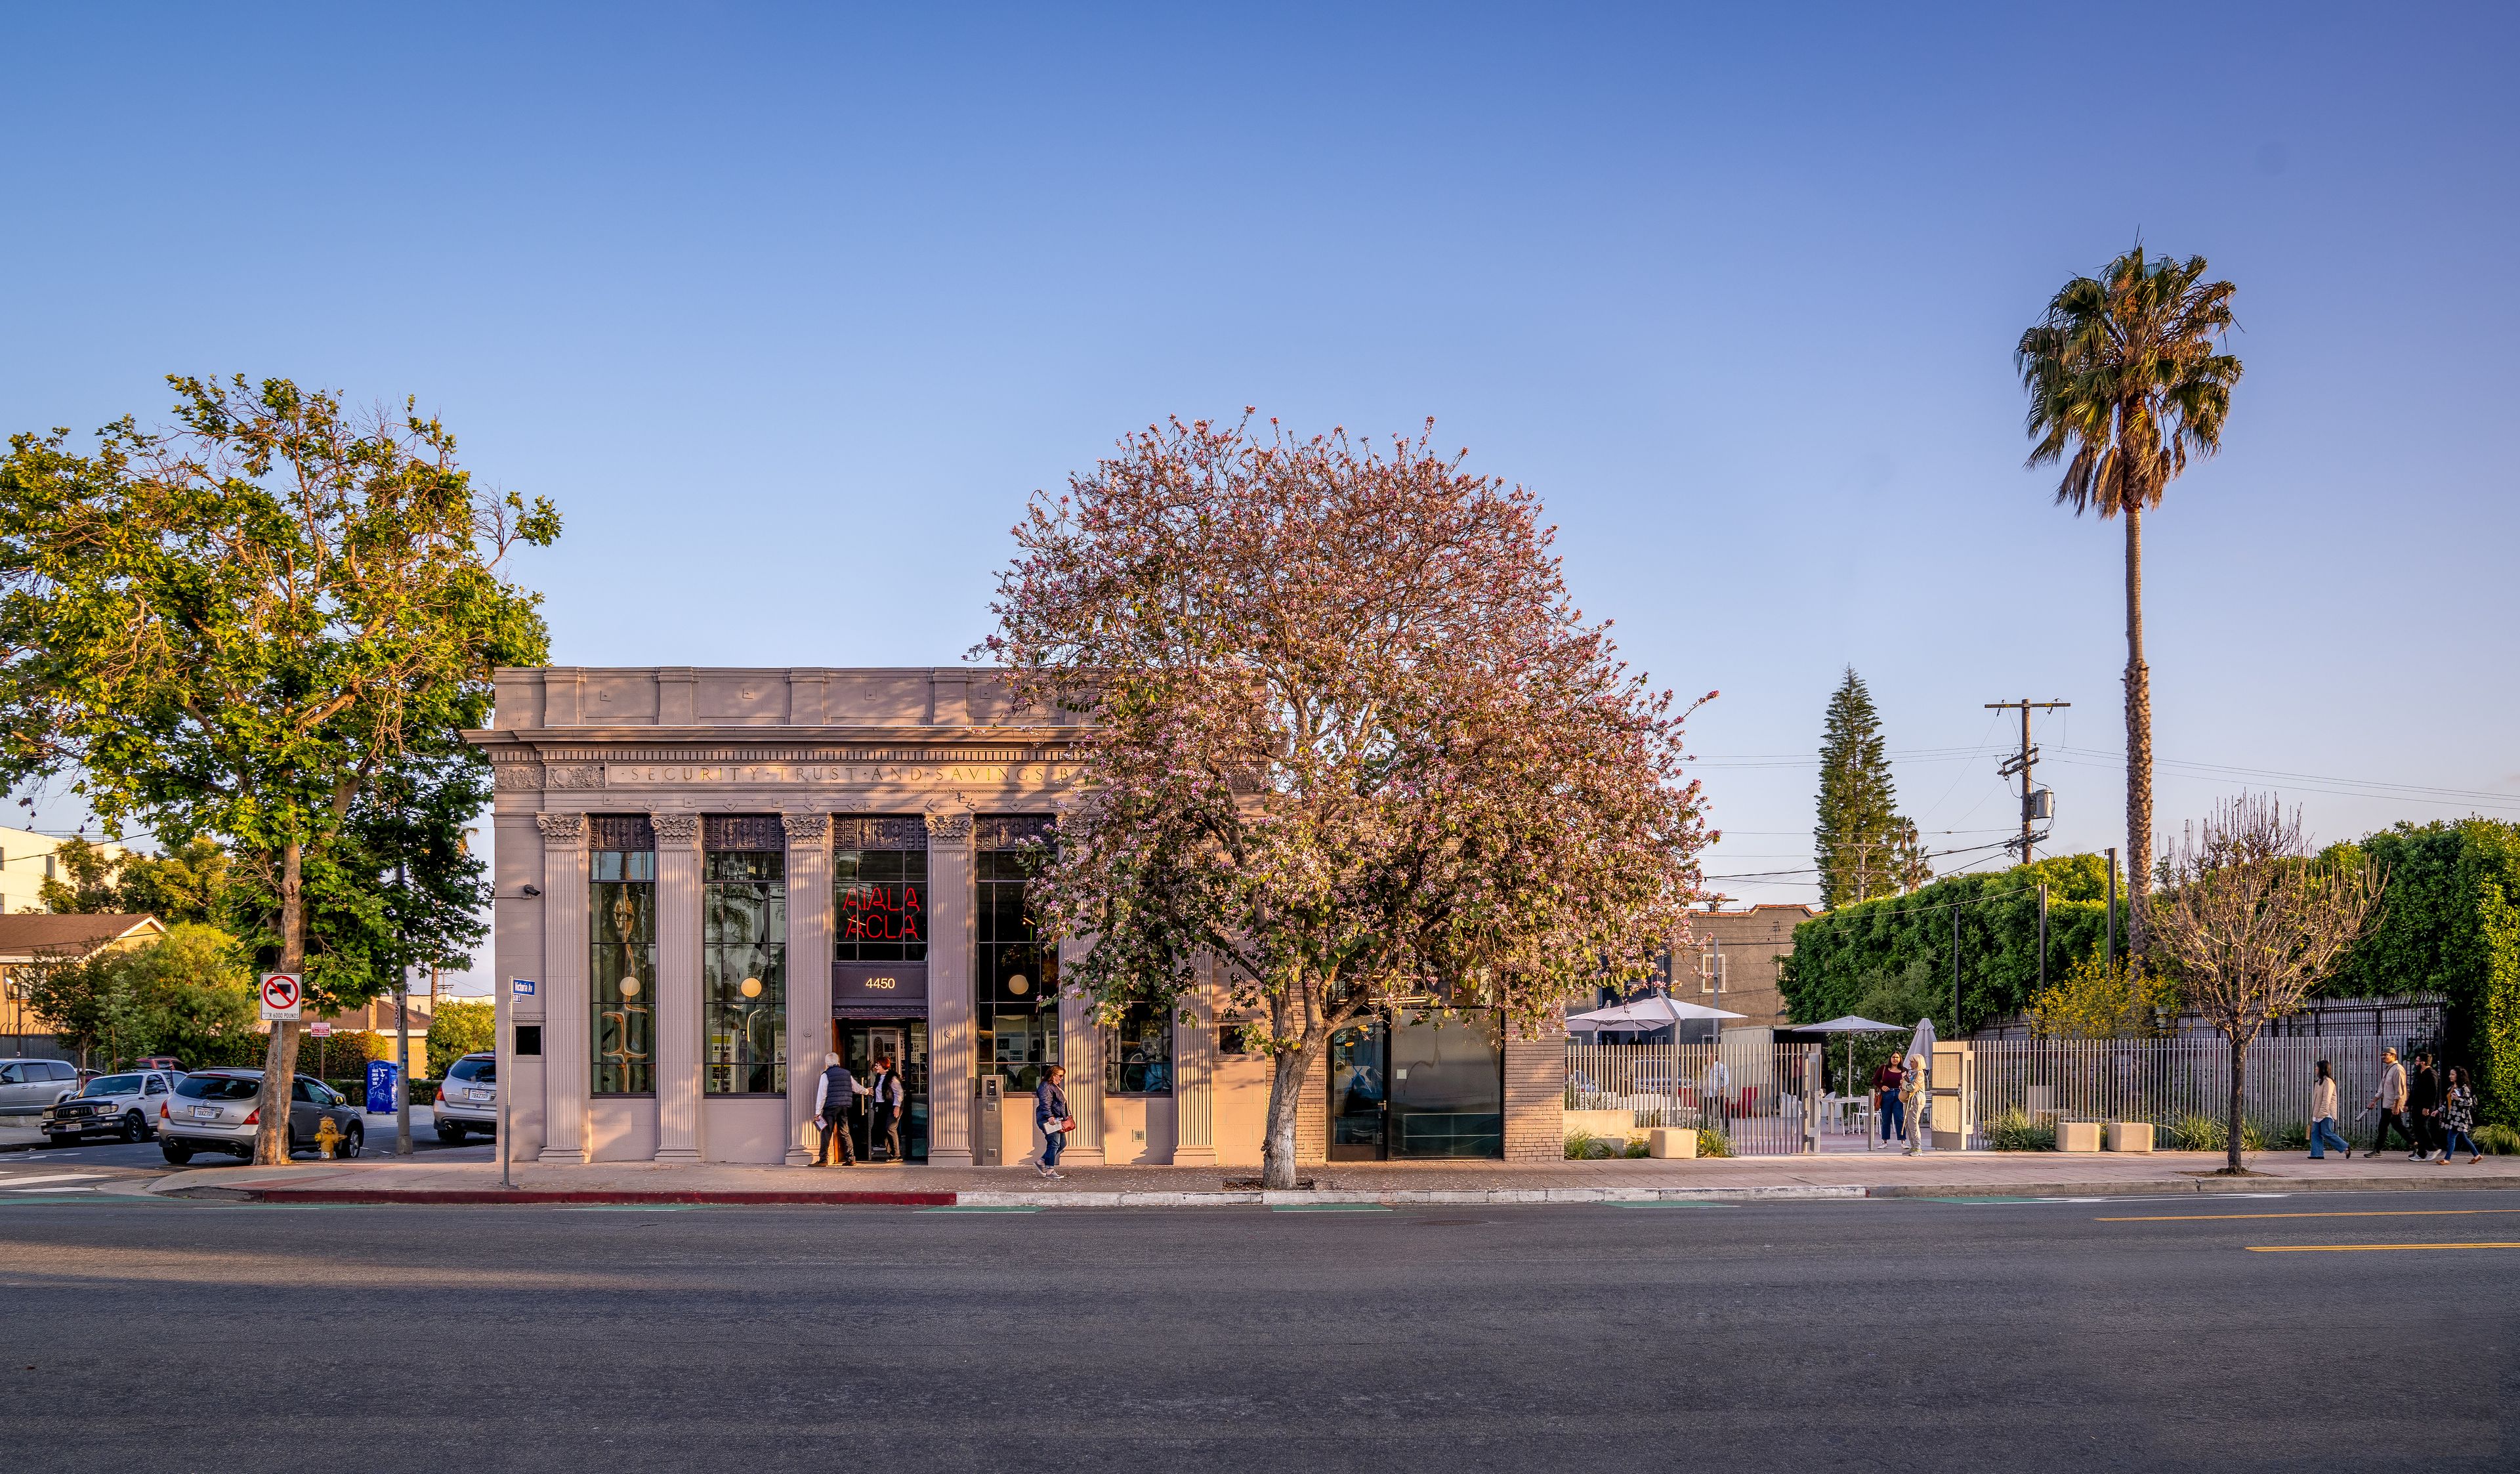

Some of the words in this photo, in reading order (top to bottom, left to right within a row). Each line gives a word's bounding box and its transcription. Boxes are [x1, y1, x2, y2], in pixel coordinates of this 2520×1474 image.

[631, 767, 759, 781] SECURITY
[776, 767, 857, 781] TRUST
[871, 767, 922, 781] AND
[934, 767, 1043, 781] SAVINGS
[1060, 767, 1085, 781] BA
[843, 887, 921, 912] AIALA
[845, 914, 918, 938] ACLA
[514, 981, 528, 992] Victoria
[528, 983, 533, 992] Av
[865, 978, 896, 989] 4450
